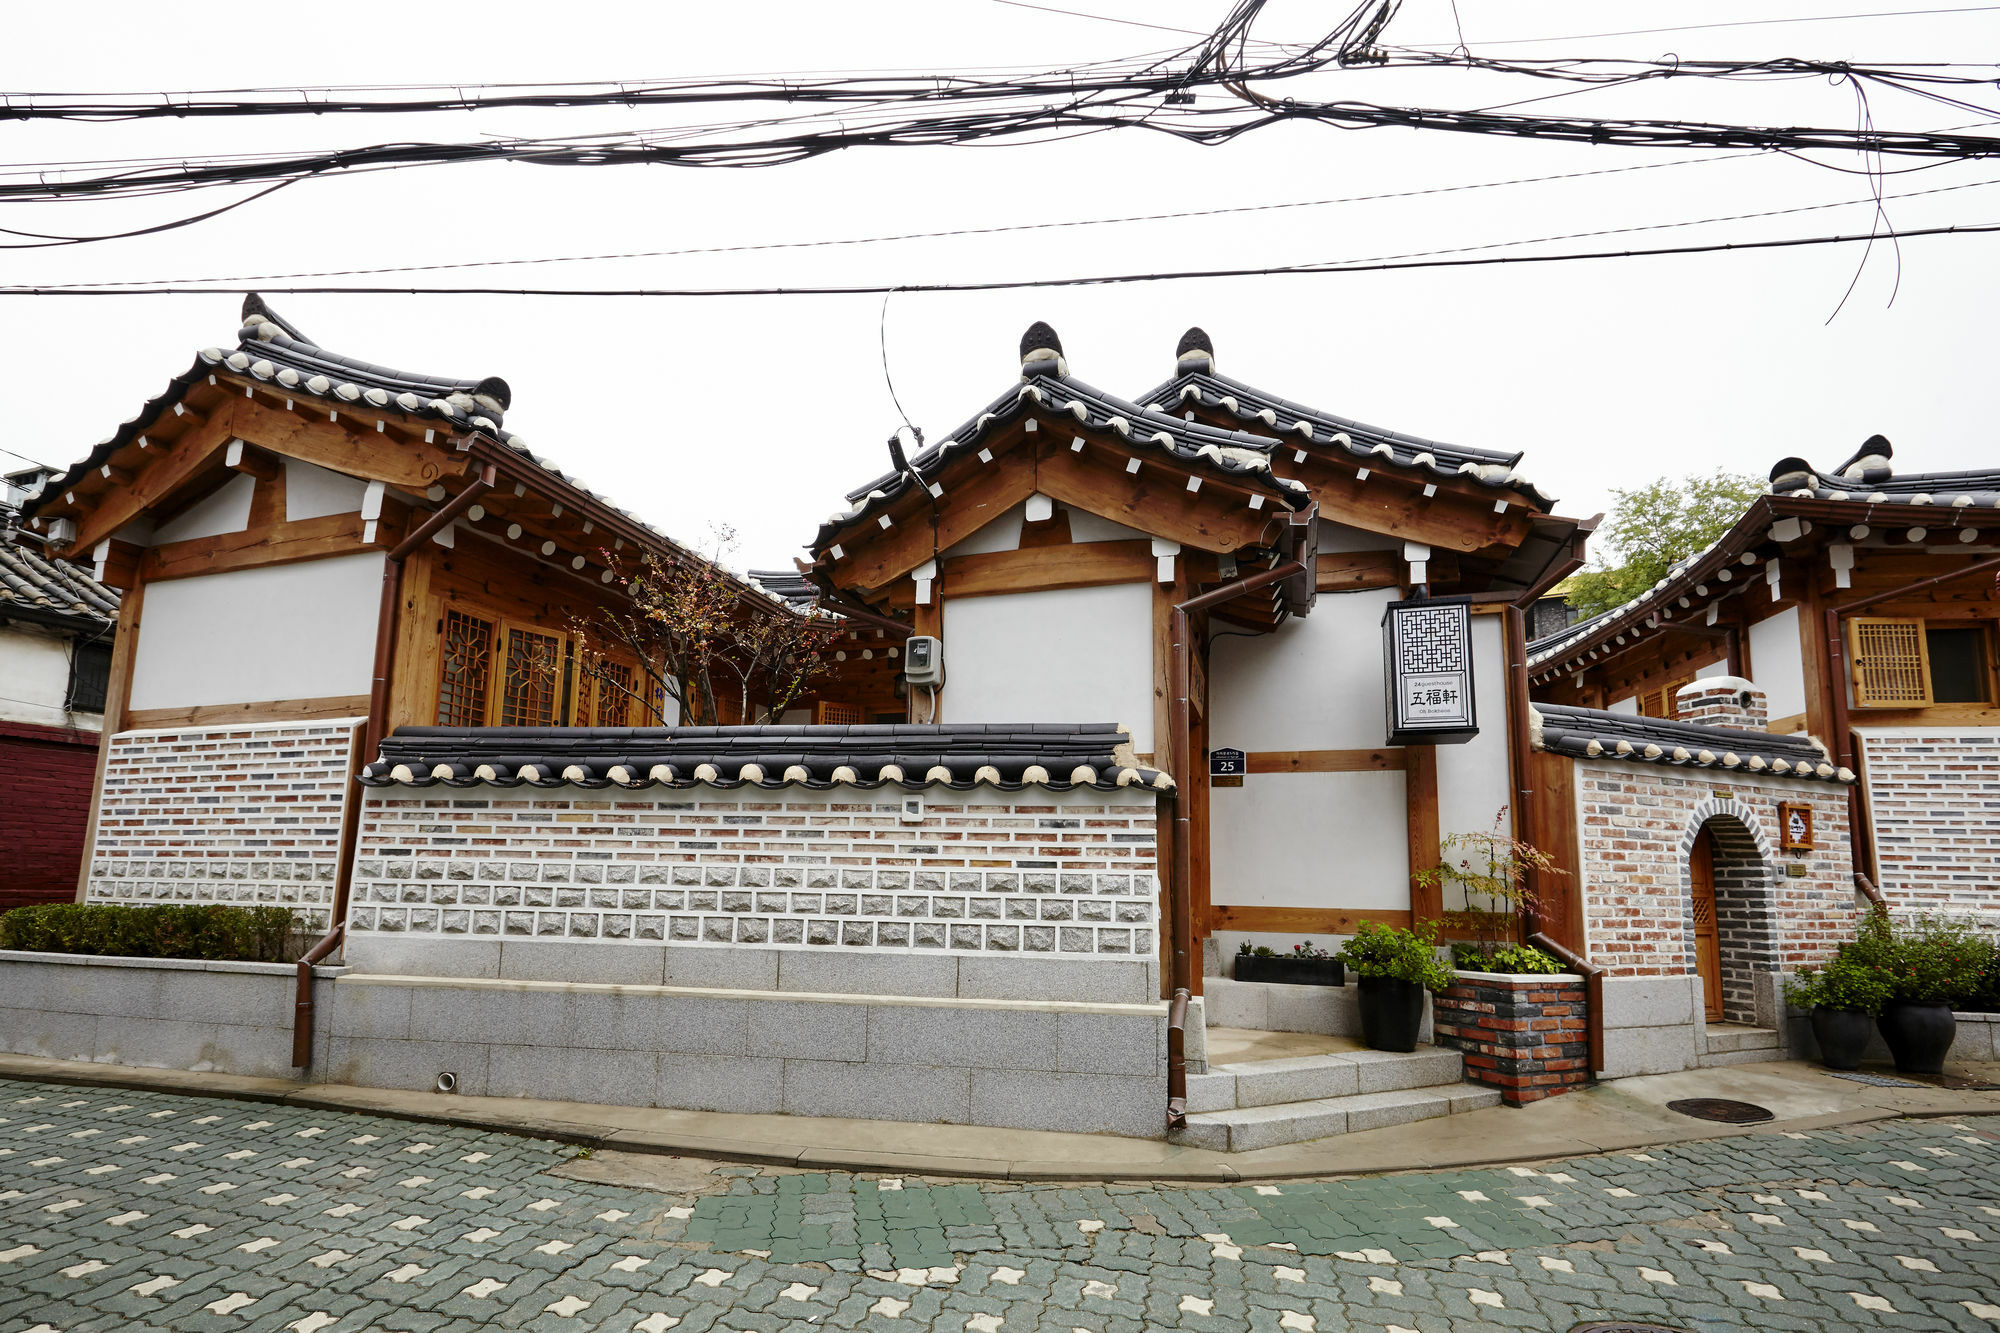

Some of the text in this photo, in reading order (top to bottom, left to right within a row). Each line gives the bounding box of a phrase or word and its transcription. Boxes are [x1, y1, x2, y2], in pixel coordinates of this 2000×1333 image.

[1410, 689, 1458, 706] 五福軒
[1220, 761, 1235, 771] 25
